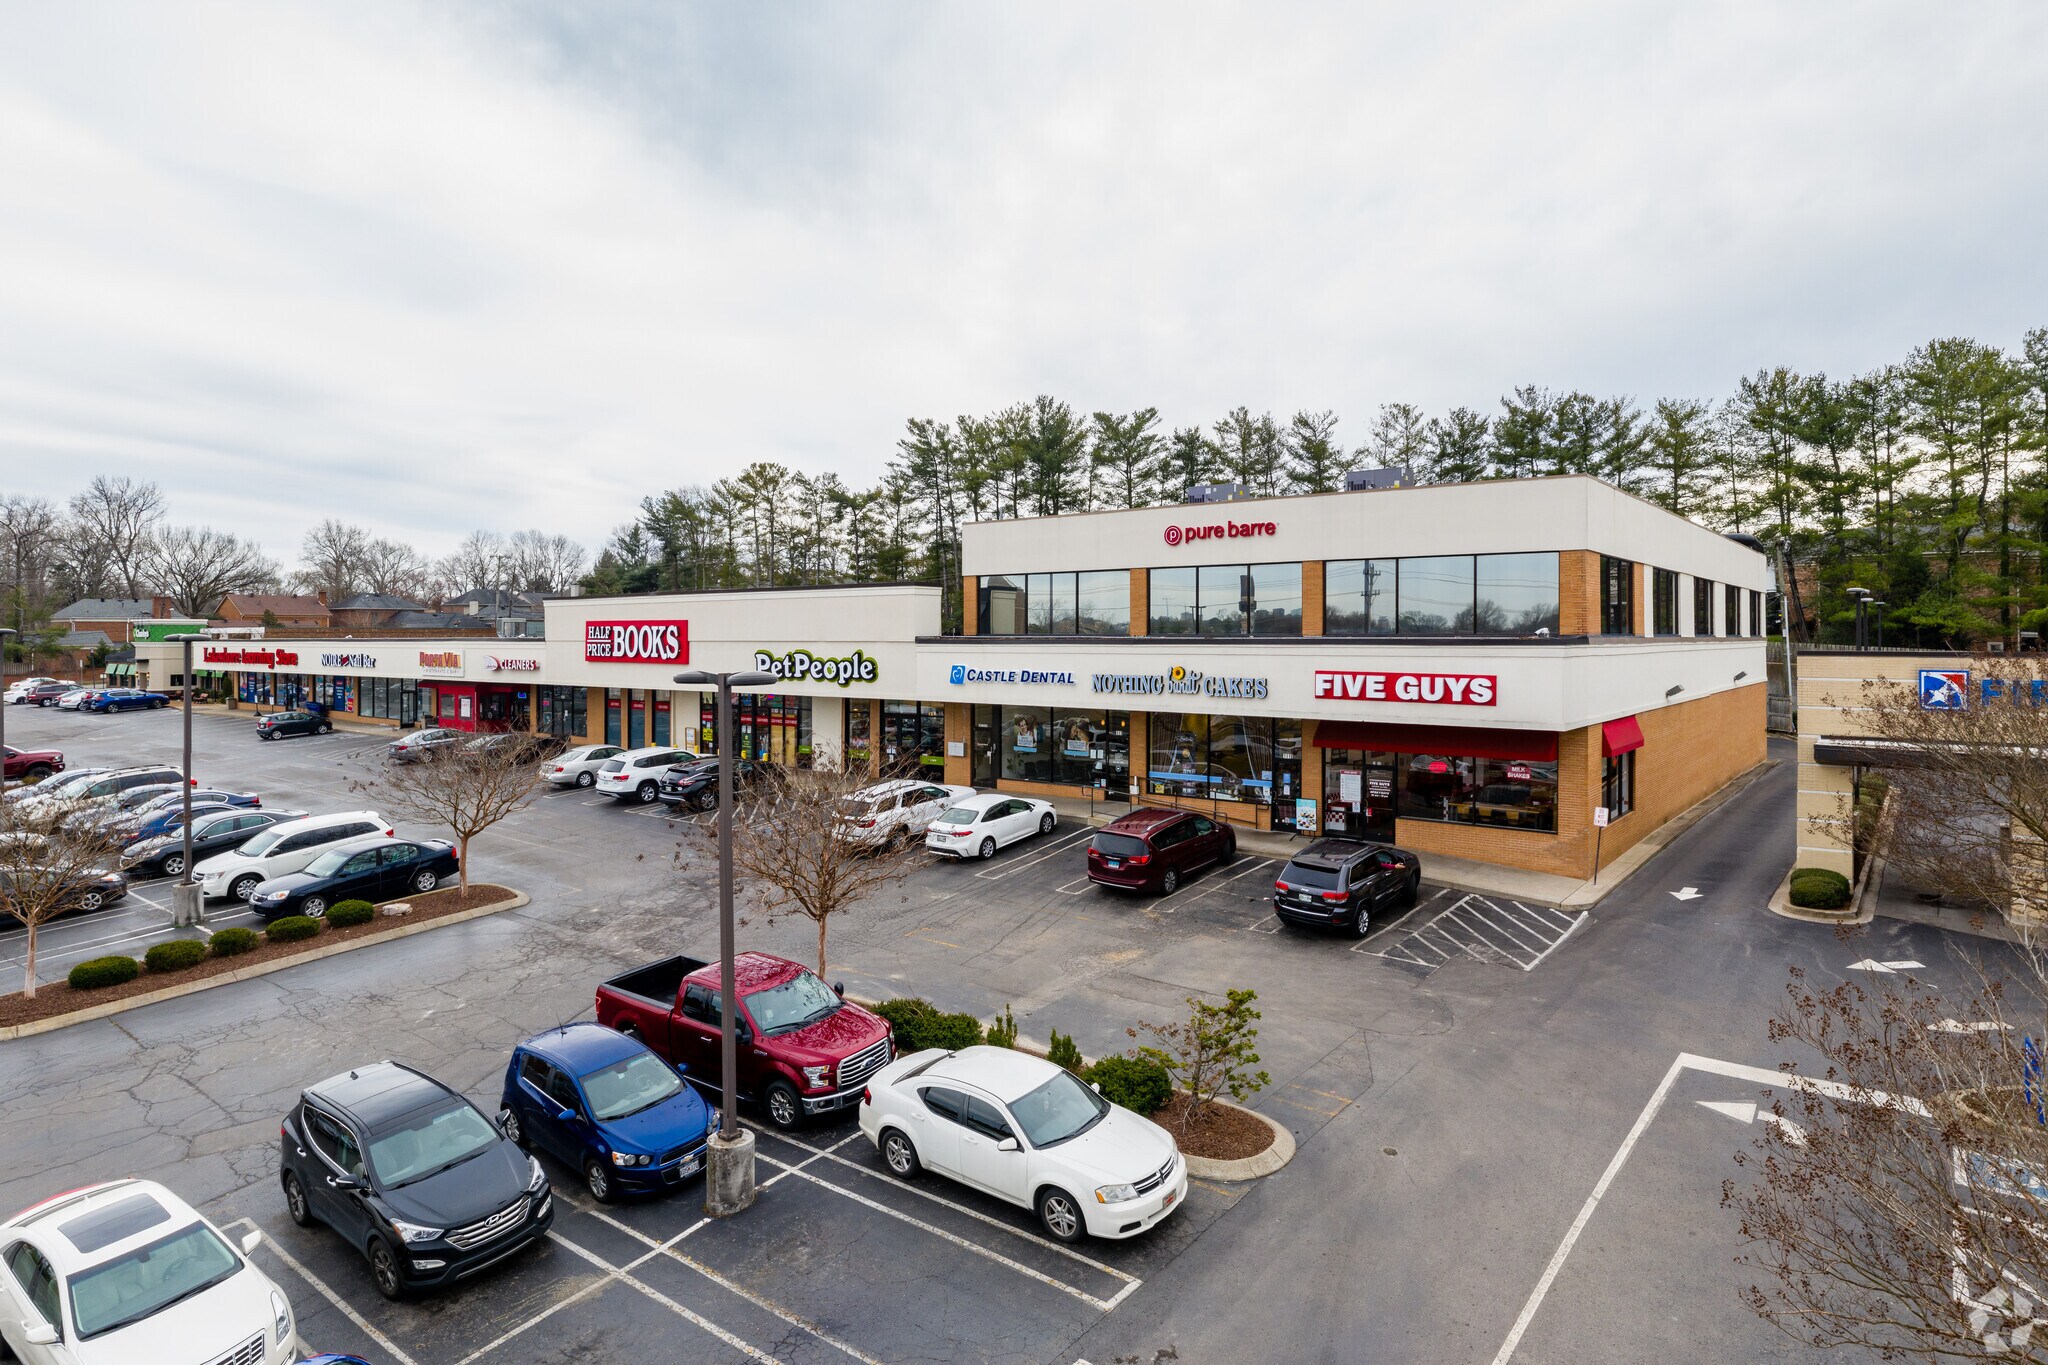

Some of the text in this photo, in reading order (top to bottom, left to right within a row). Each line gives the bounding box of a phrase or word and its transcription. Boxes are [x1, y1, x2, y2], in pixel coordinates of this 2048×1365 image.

[1185, 525, 1225, 544] pure
[1227, 520, 1276, 538] barre
[588, 626, 611, 638] HALF
[612, 625, 679, 660] BOOKS
[276, 648, 298, 666] Store
[587, 643, 611, 656] PRICE
[500, 659, 535, 670] CLEANERS
[755, 650, 877, 685] PetPeople
[967, 668, 1076, 685] CASTLE DENTAL
[1091, 674, 1164, 695] NOTHING
[1203, 677, 1268, 700] CAKES
[1315, 674, 1493, 704] FIVE GUYS
